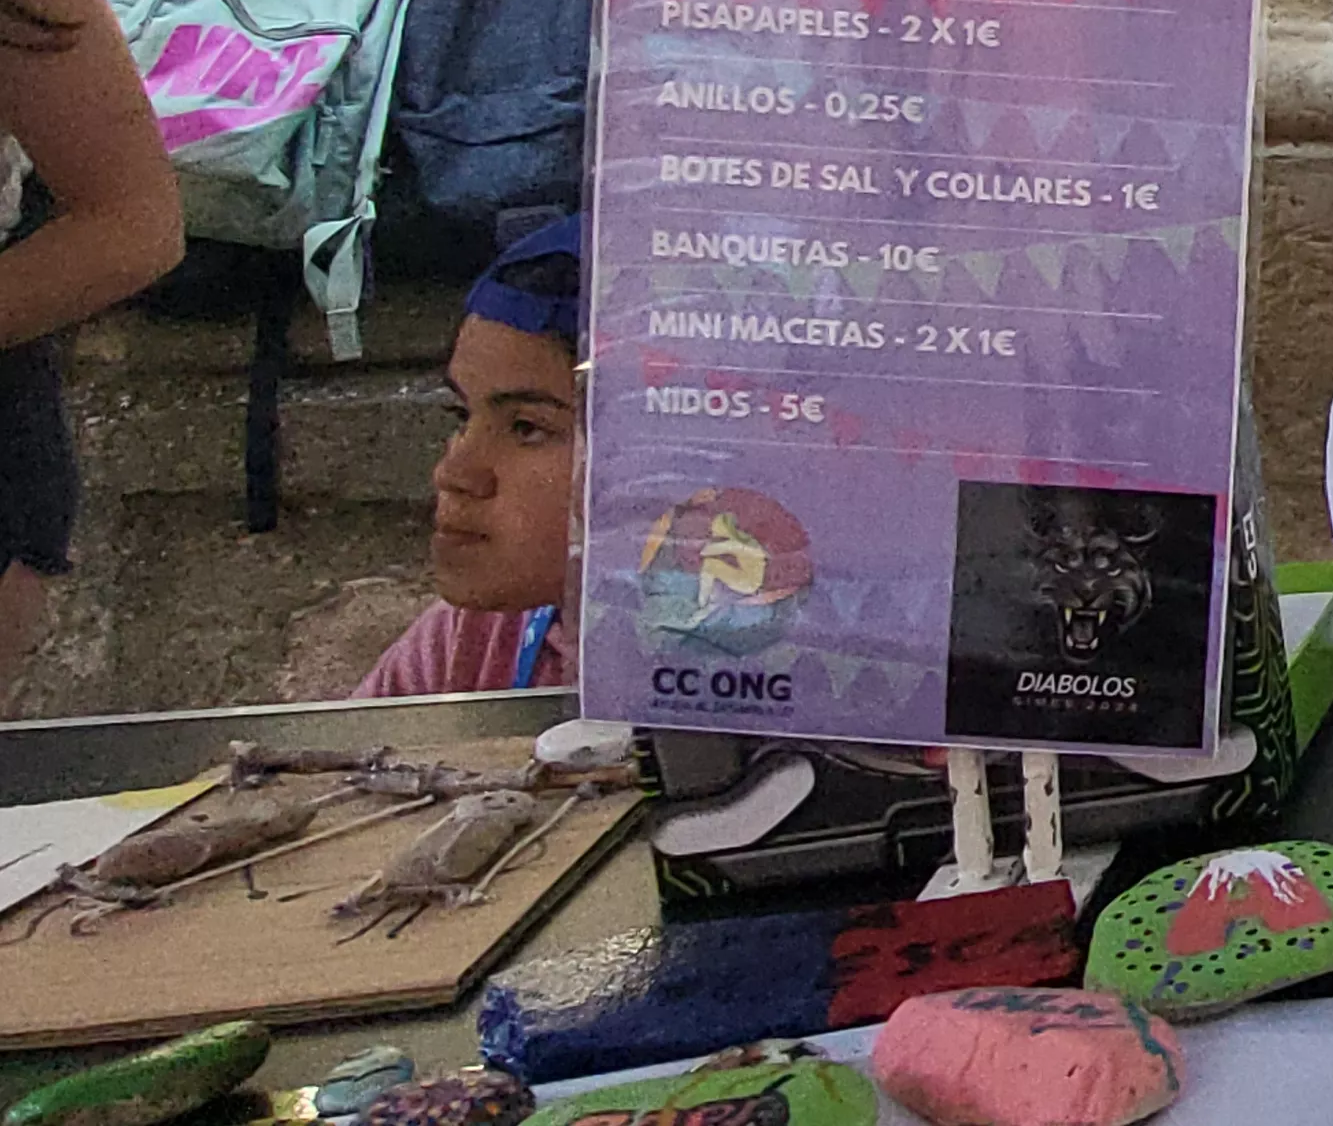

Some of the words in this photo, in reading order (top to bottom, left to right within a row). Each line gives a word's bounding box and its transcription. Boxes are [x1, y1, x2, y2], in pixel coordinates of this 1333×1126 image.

[661, 0, 871, 40] PISAPAPELES
[900, 15, 922, 43] 2
[928, 17, 956, 46] X
[963, 19, 1001, 47] 1€
[146, 23, 348, 108] NIKE
[656, 80, 796, 115] ANILLOS
[660, 154, 763, 188] BOTES
[770, 160, 811, 189] DE
[818, 163, 880, 195] SAL
[896, 168, 920, 197] Y
[926, 171, 1092, 207] COLLARES
[1121, 183, 1160, 211] 1€
[652, 230, 849, 269] BANQUETAS
[880, 244, 941, 273] 10€
[648, 310, 722, 341] MINI
[730, 314, 885, 349] MACETAS
[914, 325, 938, 353] 2
[944, 326, 971, 355] X
[978, 329, 1017, 356] 1€
[645, 385, 752, 419] NIDOS
[777, 394, 826, 424] 5€
[652, 667, 700, 697] CC
[710, 669, 793, 702] ONG
[1016, 671, 1137, 699] DIABOLOS
